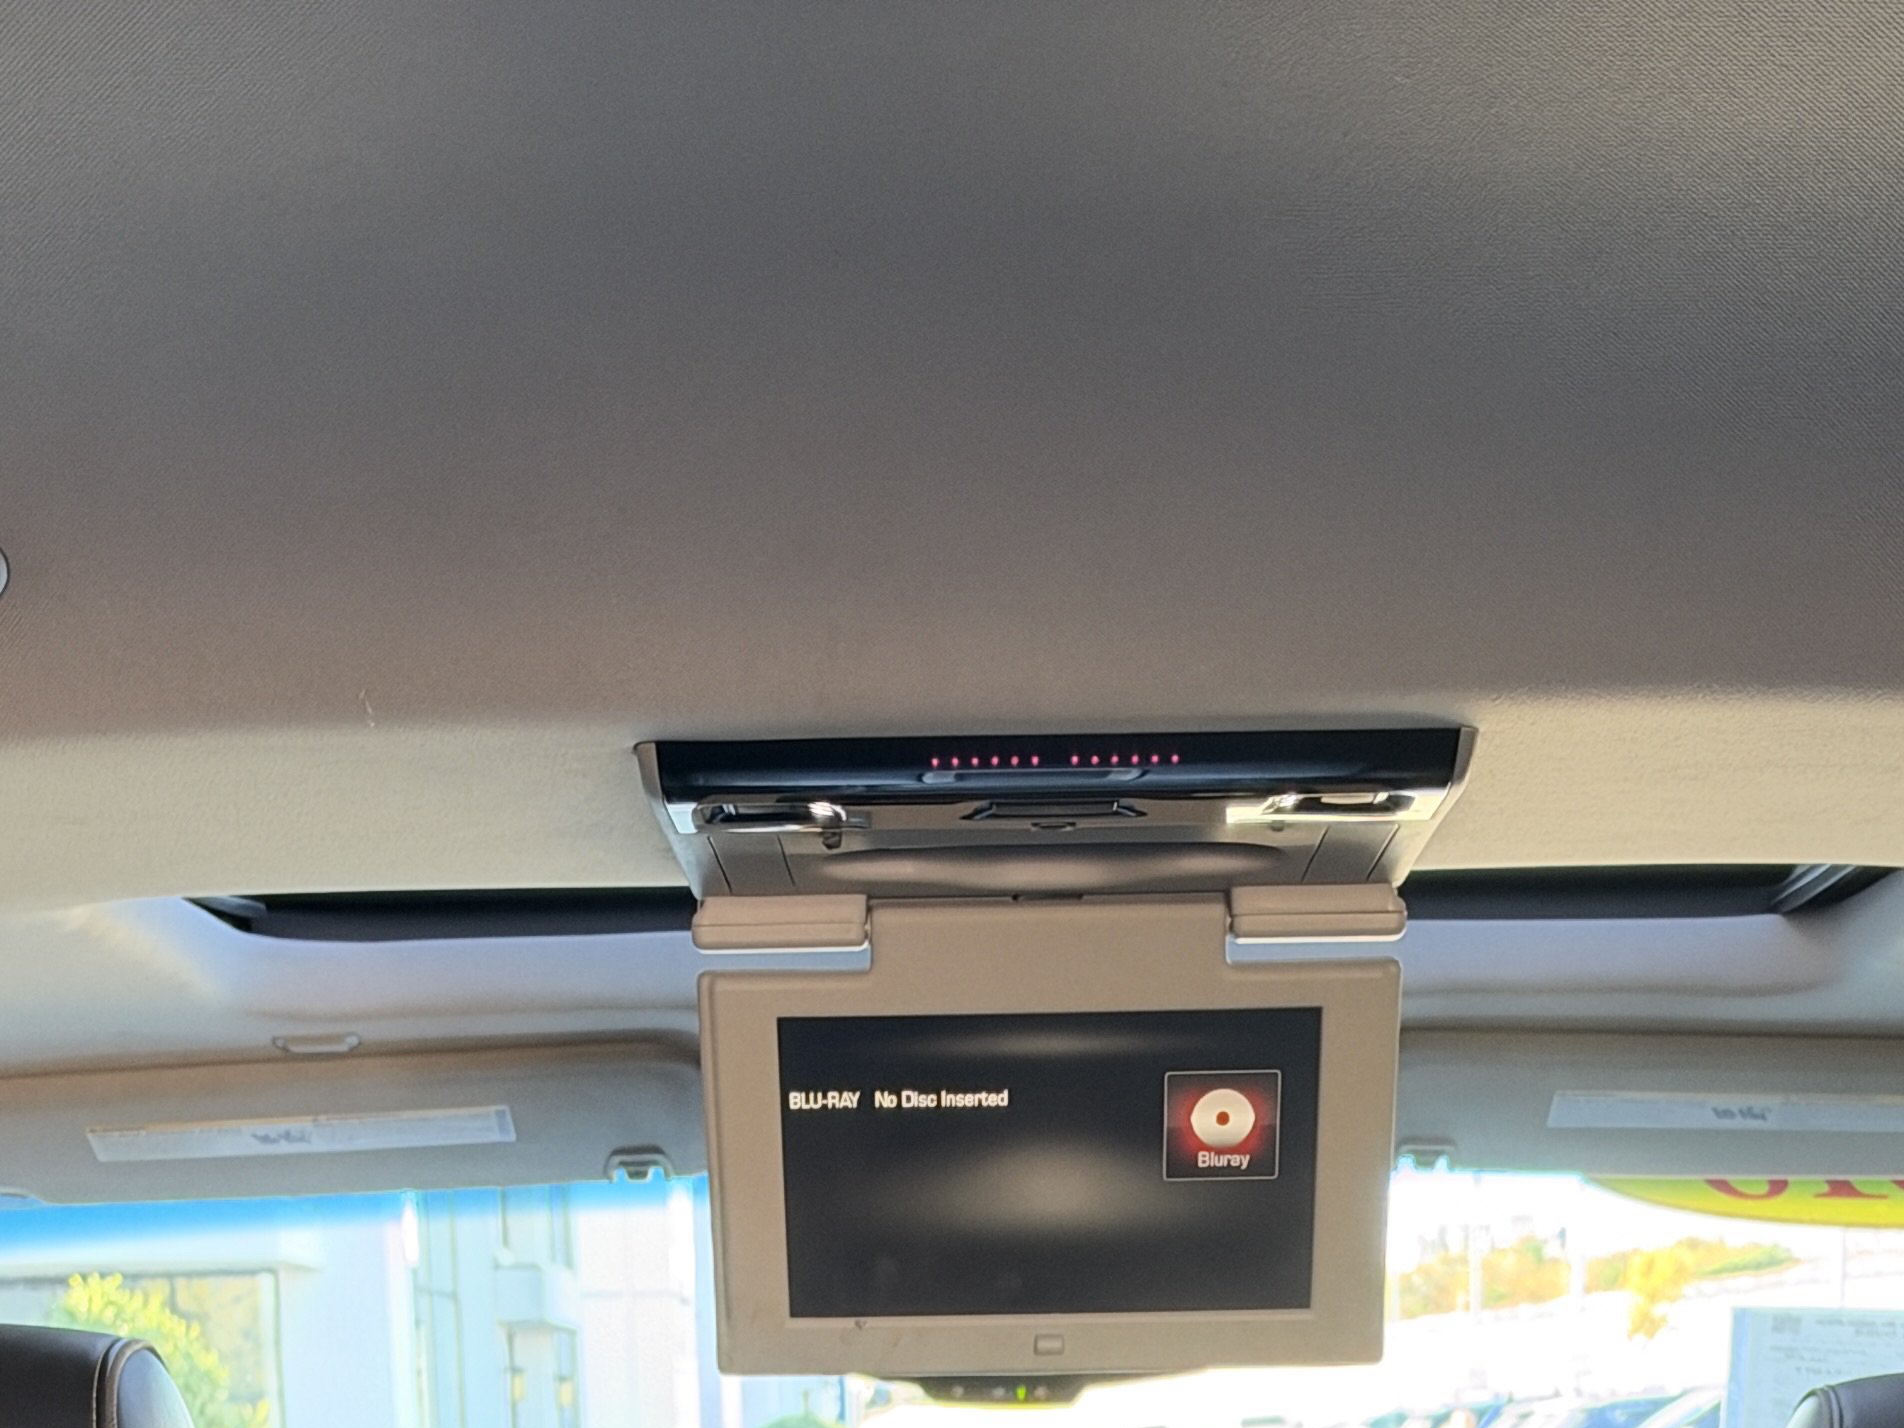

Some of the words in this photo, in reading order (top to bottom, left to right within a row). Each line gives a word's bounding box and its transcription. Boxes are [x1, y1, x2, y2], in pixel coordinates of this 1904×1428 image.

[789, 1090, 860, 1110] BLU-RAY
[874, 1090, 897, 1108] No
[901, 1090, 937, 1108] Disc
[940, 1088, 1009, 1107] Inserted
[1197, 1150, 1250, 1170] Bluray
